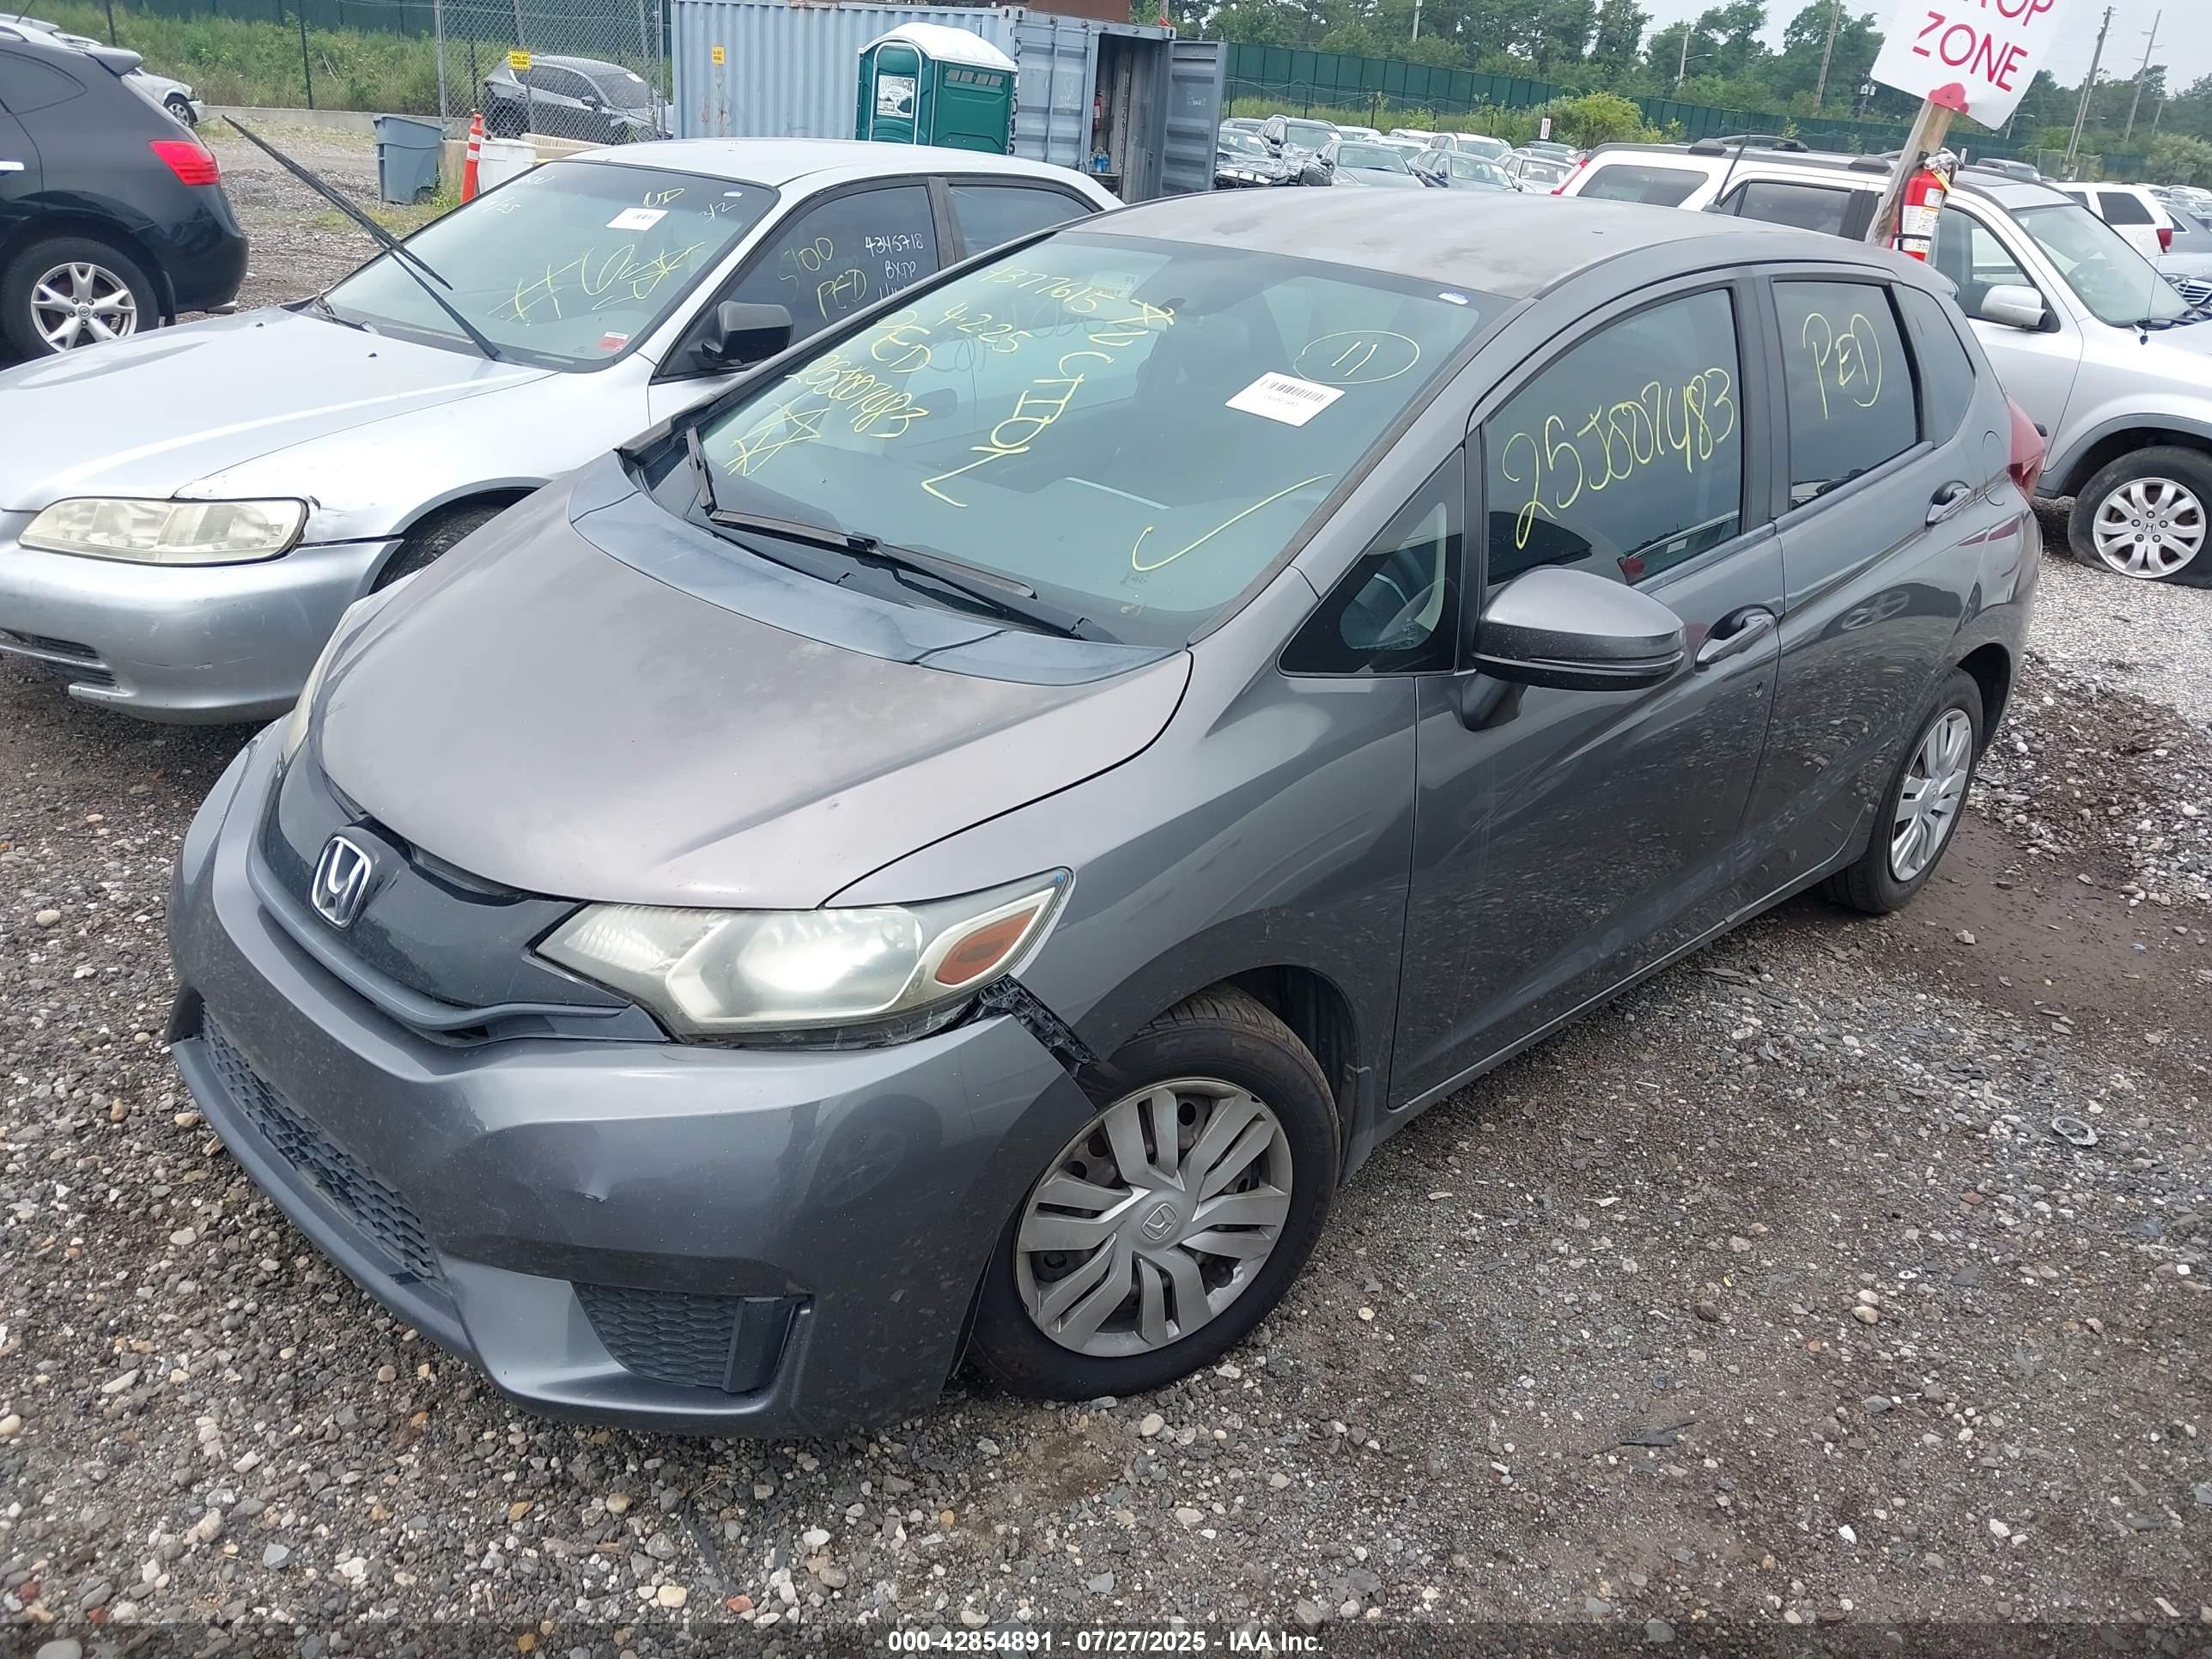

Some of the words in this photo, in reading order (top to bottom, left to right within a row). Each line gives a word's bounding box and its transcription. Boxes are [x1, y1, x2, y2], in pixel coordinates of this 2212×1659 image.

[1912, 10, 2028, 92] ZONE
[865, 233, 925, 258] 4345718
[817, 268, 867, 322] PED
[1802, 313, 1882, 420] PED
